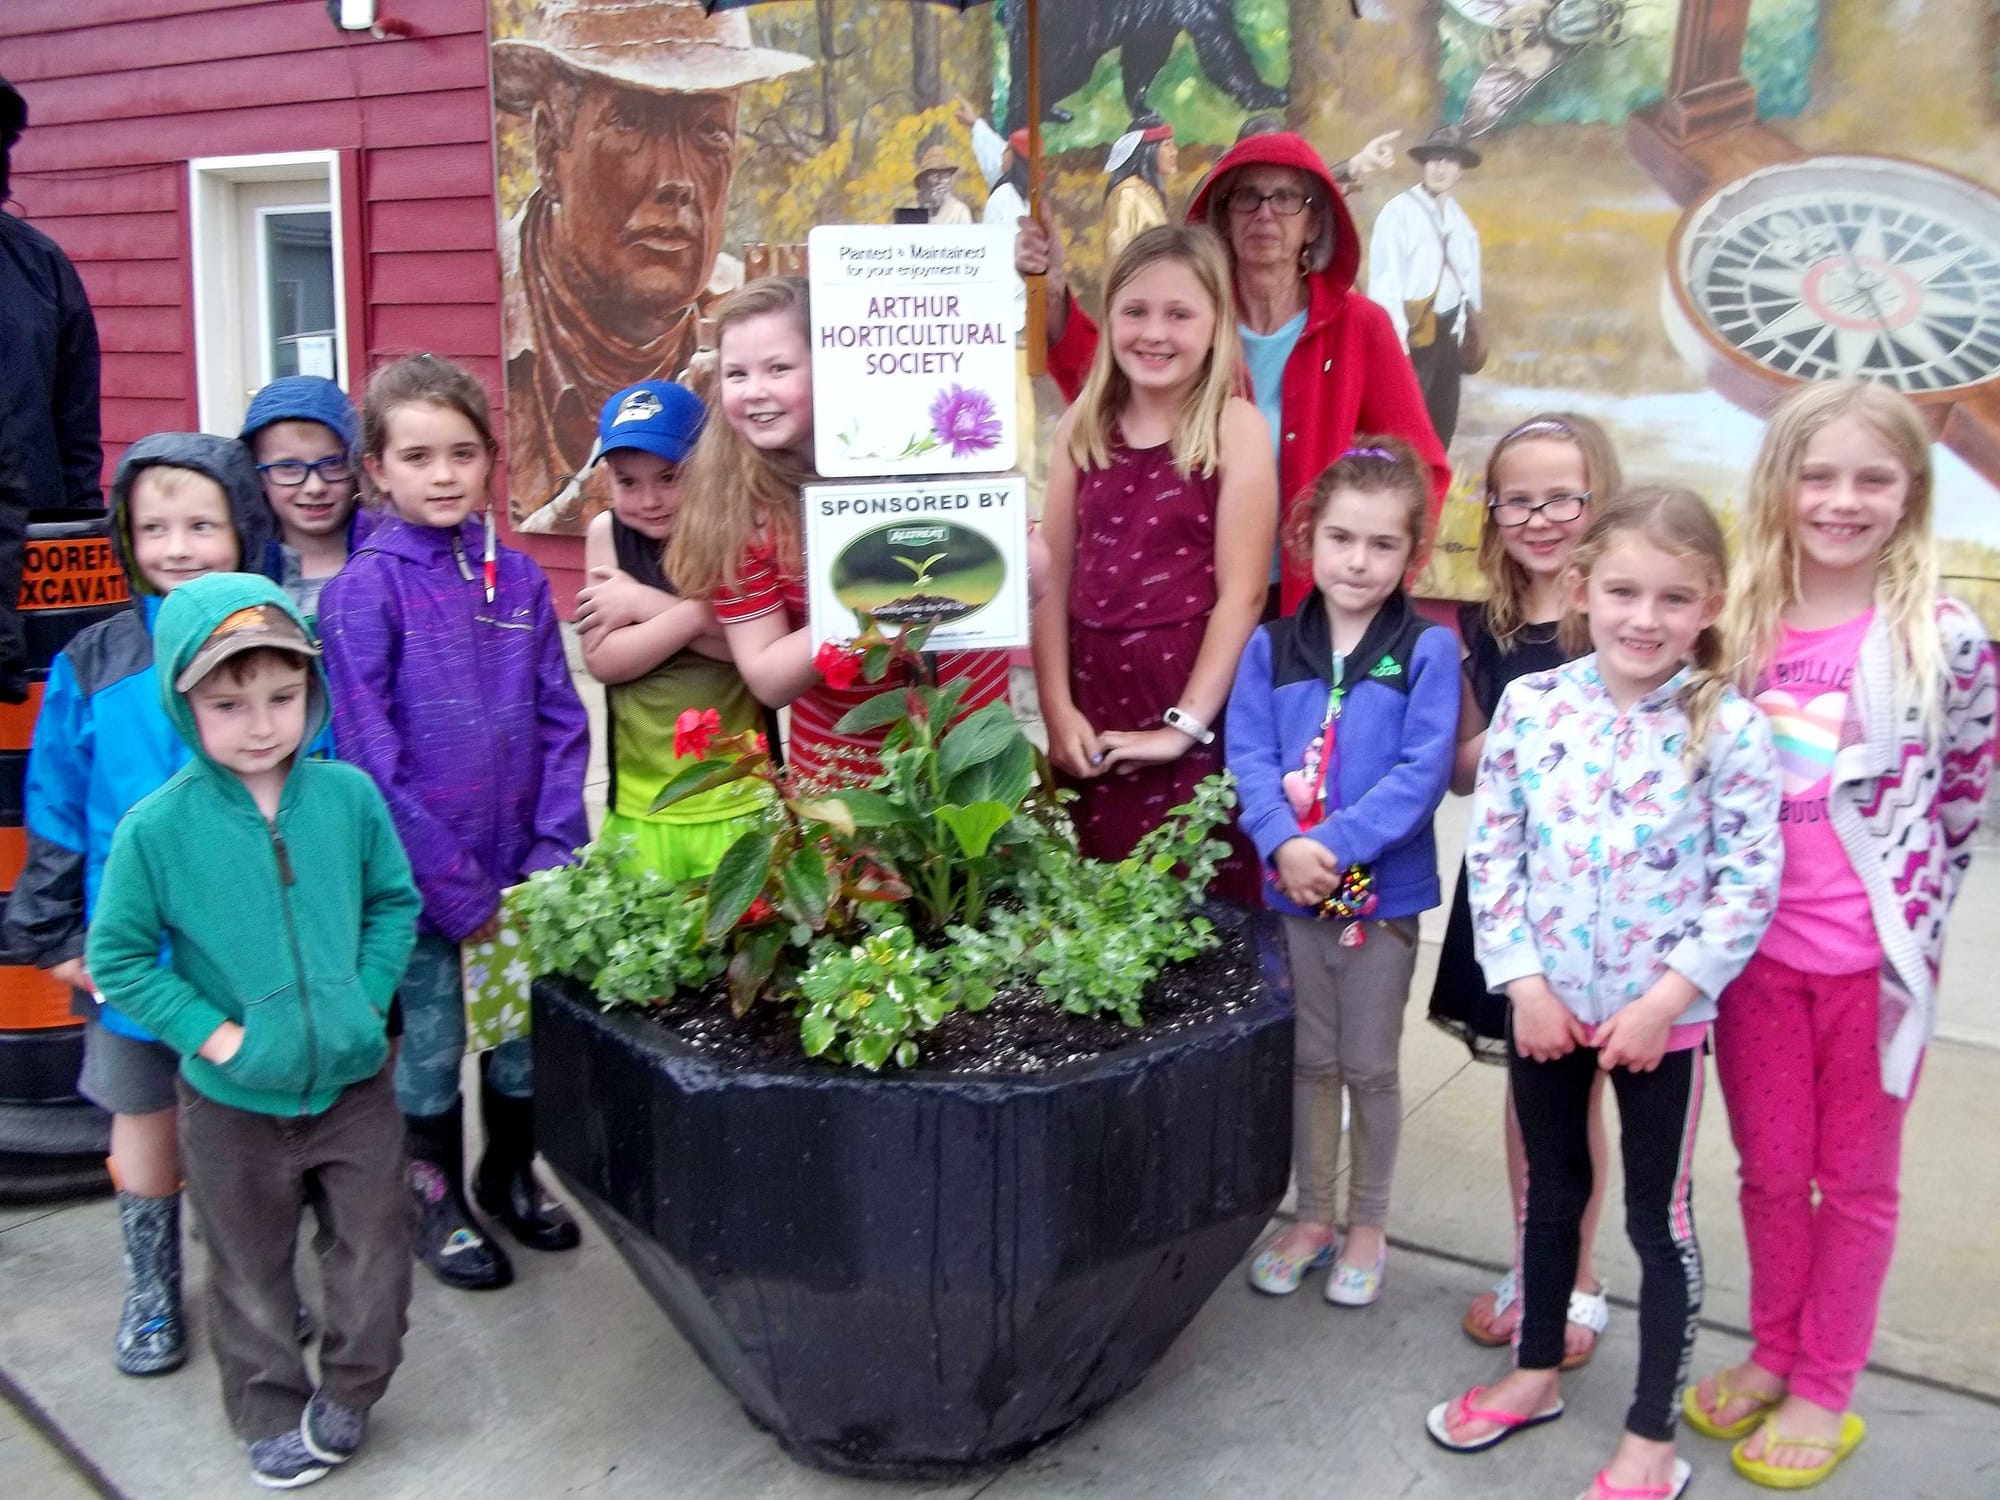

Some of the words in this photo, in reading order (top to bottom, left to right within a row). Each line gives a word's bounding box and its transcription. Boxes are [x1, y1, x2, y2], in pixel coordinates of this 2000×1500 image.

[839, 246, 893, 260] Planted
[910, 243, 986, 260] Maintained
[847, 264, 863, 276] for
[867, 266, 893, 279] your
[898, 265, 961, 280] enjoyment
[965, 263, 981, 277] by
[867, 296, 960, 319] ARTHUR
[821, 323, 1006, 348] HORTICULTURAL
[866, 352, 964, 375] SOCIETY
[821, 494, 969, 516] SPONSORED
[979, 492, 1009, 509] BY
